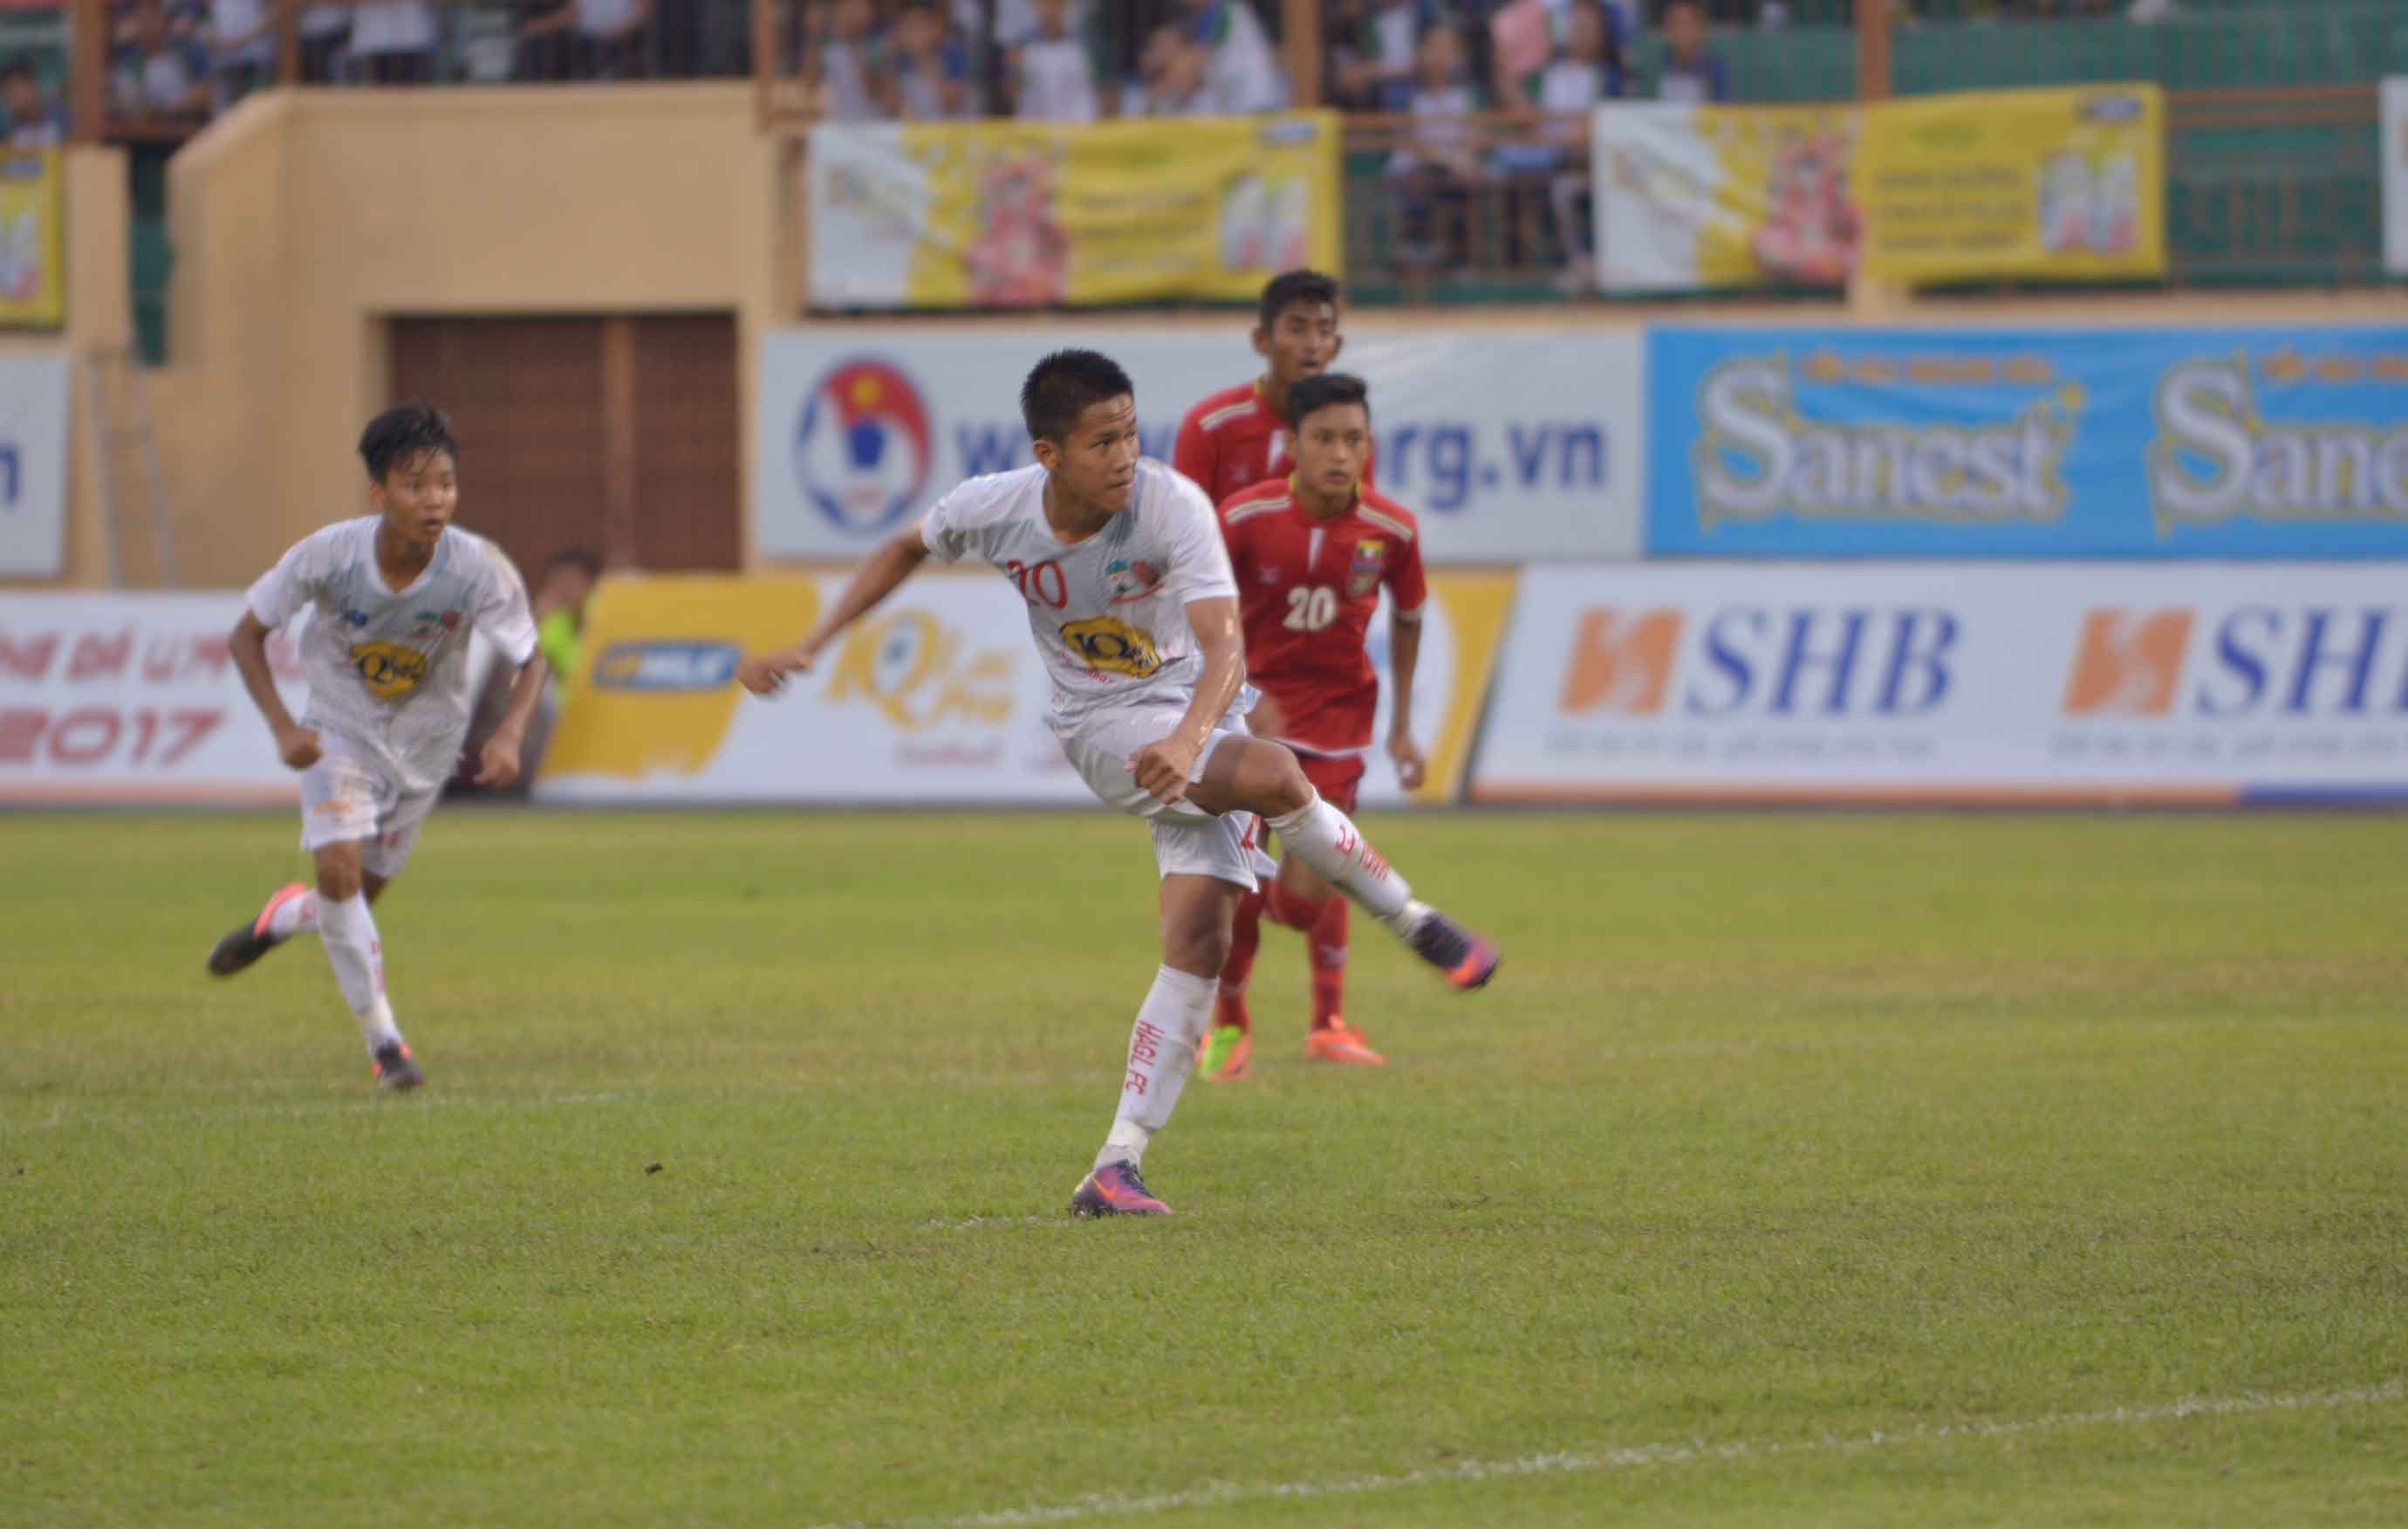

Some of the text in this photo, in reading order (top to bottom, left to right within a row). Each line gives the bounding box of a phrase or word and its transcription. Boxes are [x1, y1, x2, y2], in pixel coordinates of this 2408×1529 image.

[1282, 585, 1337, 632] 20
[1686, 606, 1958, 719] SHB
[2193, 606, 2408, 717] SH
